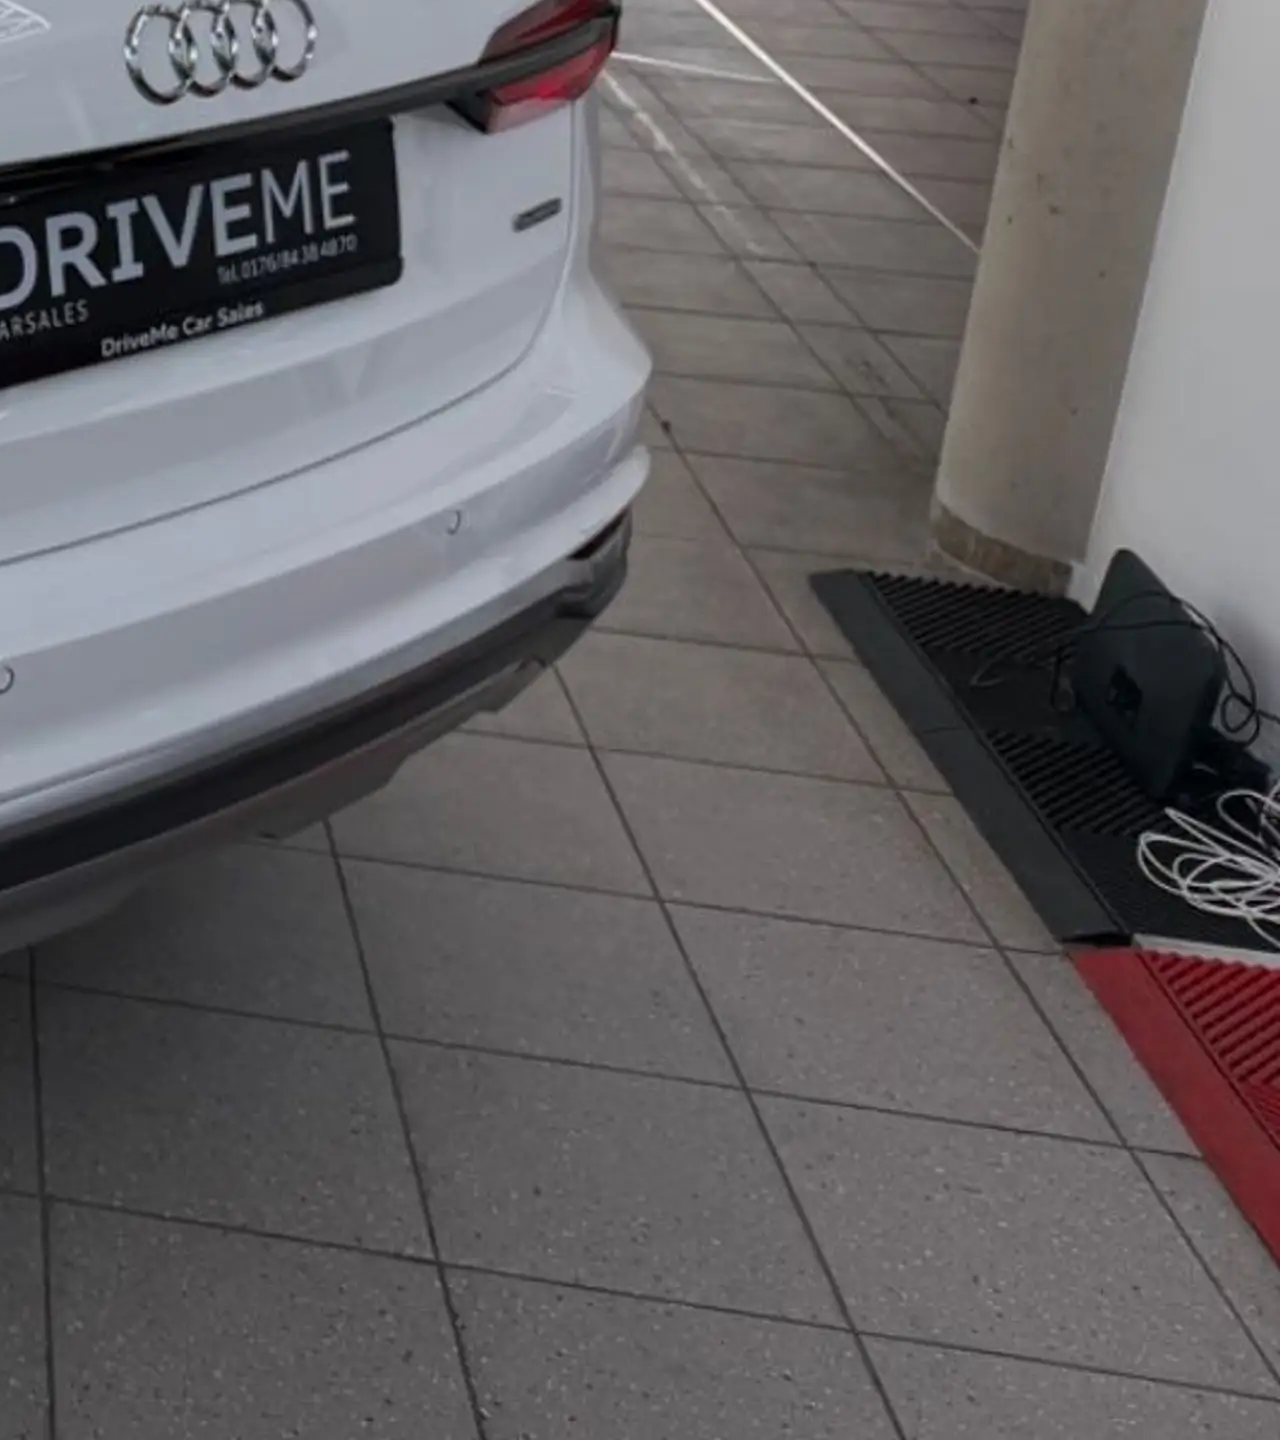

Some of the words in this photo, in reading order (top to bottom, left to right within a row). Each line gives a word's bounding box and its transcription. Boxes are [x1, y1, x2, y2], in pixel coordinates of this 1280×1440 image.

[100, 322, 179, 358] DriveMe
[182, 316, 212, 336] Car
[217, 301, 264, 327] Sales
